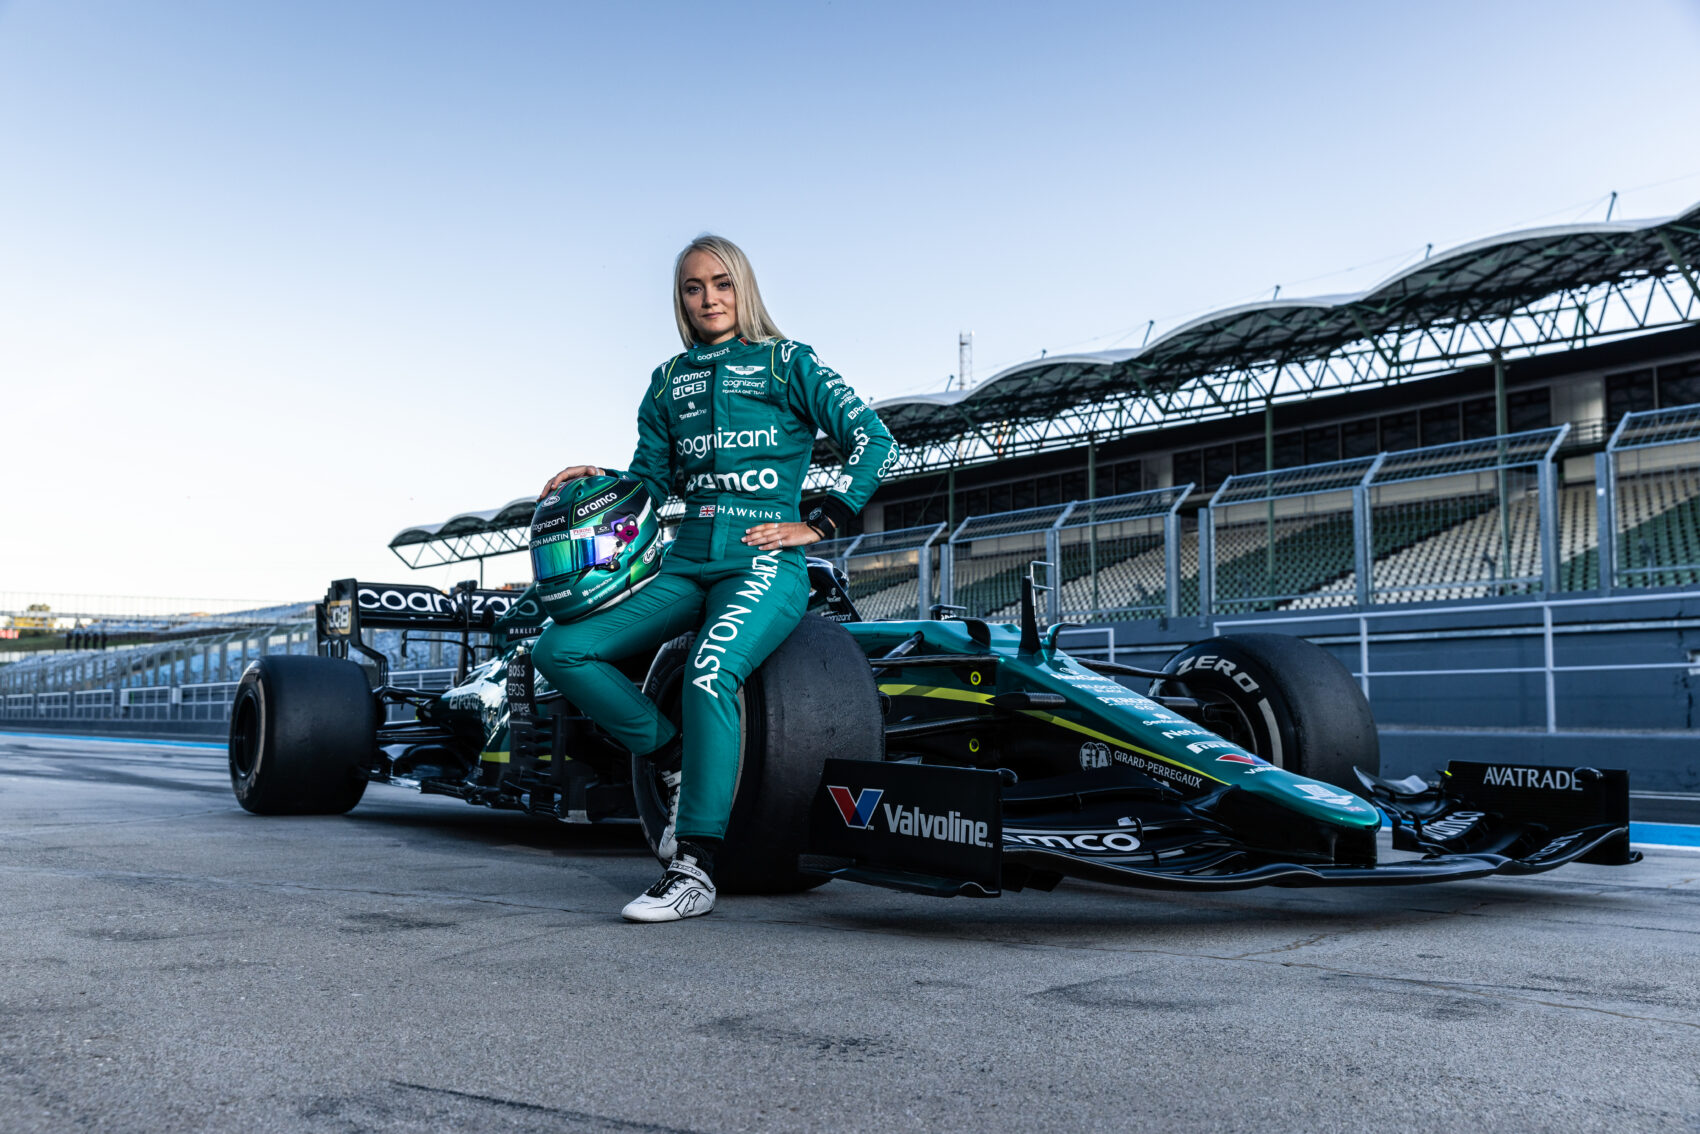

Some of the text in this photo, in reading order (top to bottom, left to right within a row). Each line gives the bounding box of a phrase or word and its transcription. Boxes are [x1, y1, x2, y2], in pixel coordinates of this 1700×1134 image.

[697, 347, 730, 361] cognizant
[672, 370, 711, 384] aramco
[722, 379, 766, 388] cognizant
[674, 382, 705, 398] JCB
[676, 425, 778, 459] cognizant
[577, 492, 617, 517] aramco
[717, 504, 782, 520] HAWKINS
[542, 532, 569, 545] MARTIN
[509, 627, 537, 635] OAKLEY
[692, 604, 752, 699] ASTON
[508, 664, 525, 677] BOSS
[1176, 655, 1260, 693] ZERO
[1114, 750, 1204, 789] GIRARD-PERREGAUX
[1483, 766, 1584, 792] AVATRADE
[883, 803, 988, 848] Valvoline
